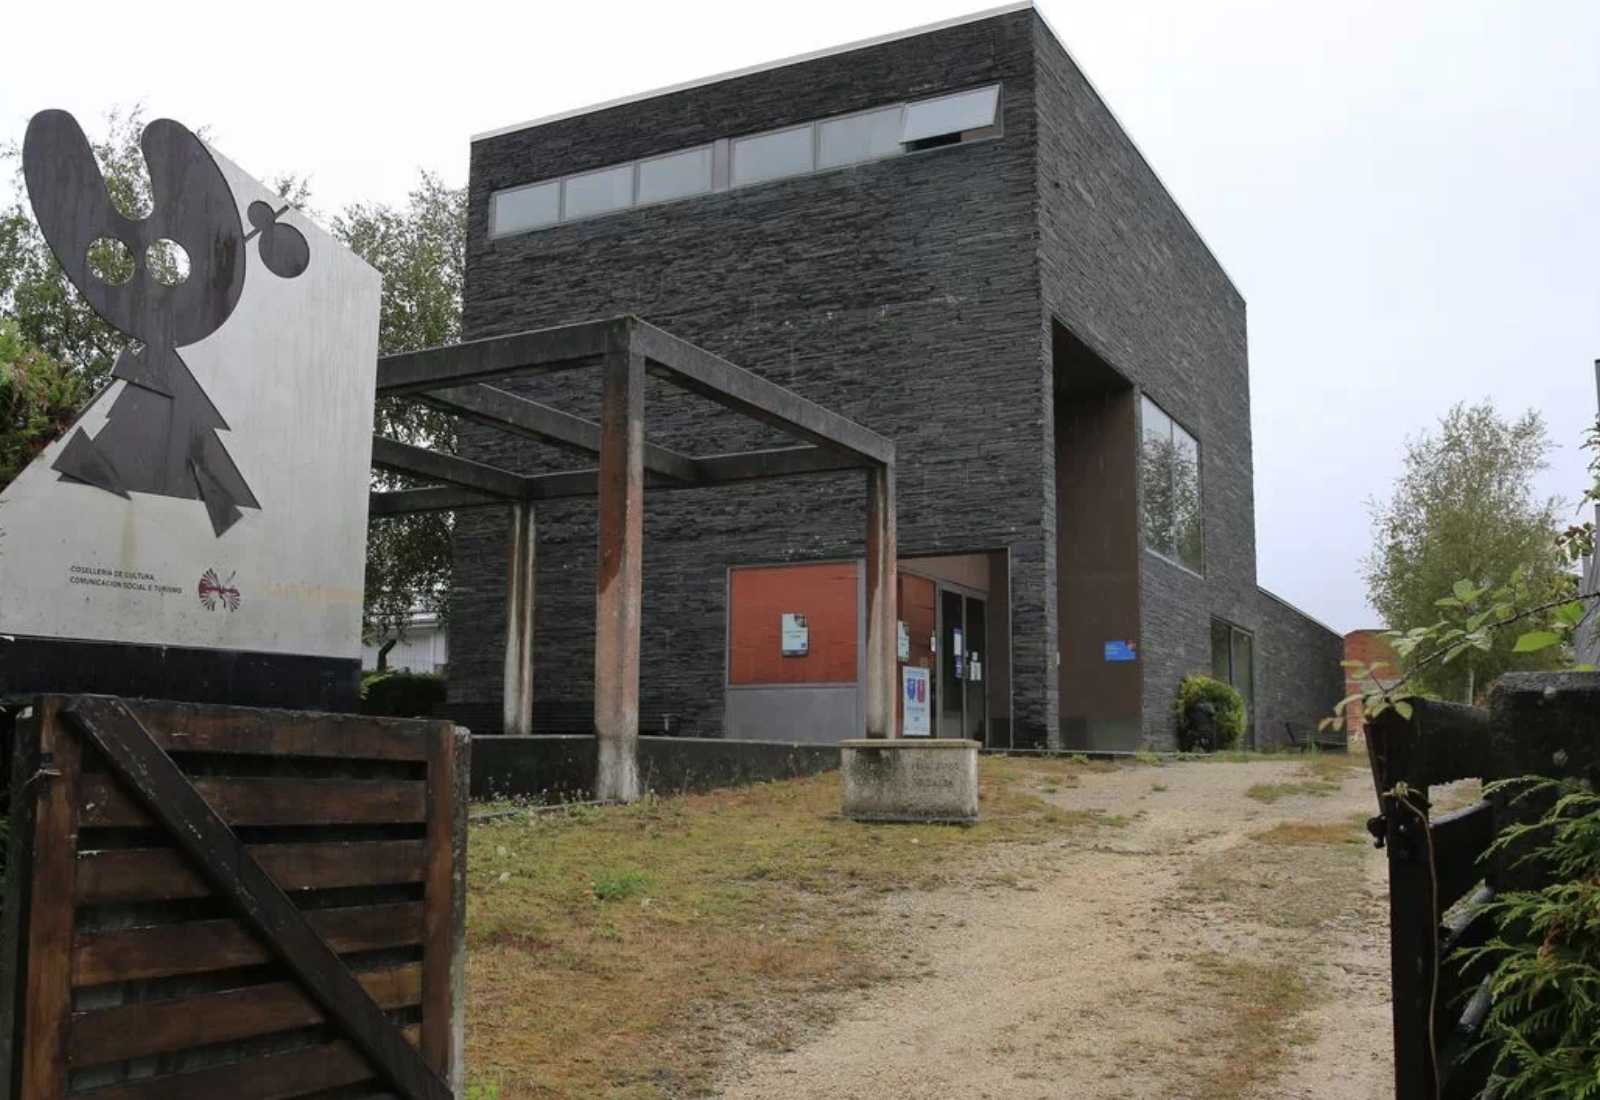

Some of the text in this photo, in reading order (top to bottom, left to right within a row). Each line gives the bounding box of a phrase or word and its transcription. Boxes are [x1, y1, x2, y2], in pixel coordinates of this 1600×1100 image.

[114, 570, 122, 578] DE
[124, 572, 154, 581] CULTURA
[123, 581, 146, 591] SOCIAL
[154, 584, 182, 594] TURISMO
